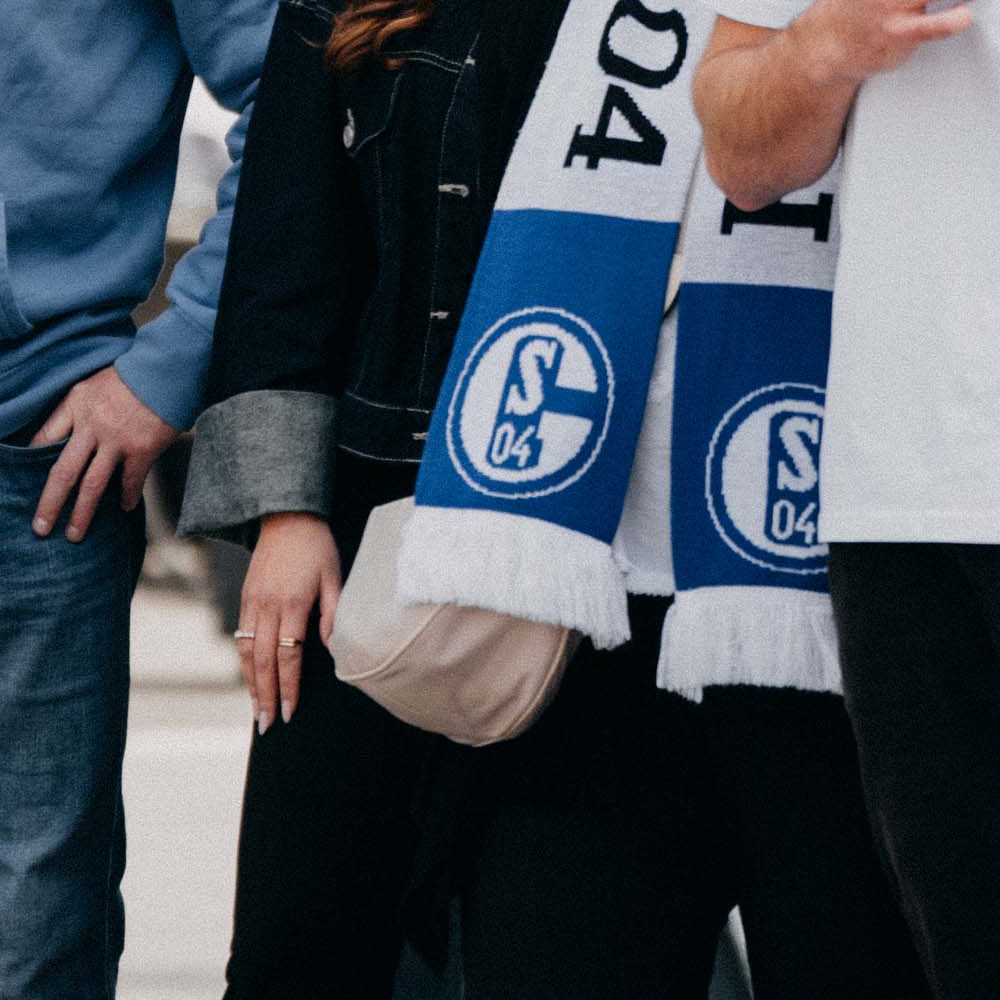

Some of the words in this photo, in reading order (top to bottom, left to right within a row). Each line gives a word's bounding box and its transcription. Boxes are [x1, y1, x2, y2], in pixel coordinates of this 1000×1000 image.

[504, 340, 559, 416] S
[491, 421, 536, 467] 04
[771, 499, 817, 544] 04
